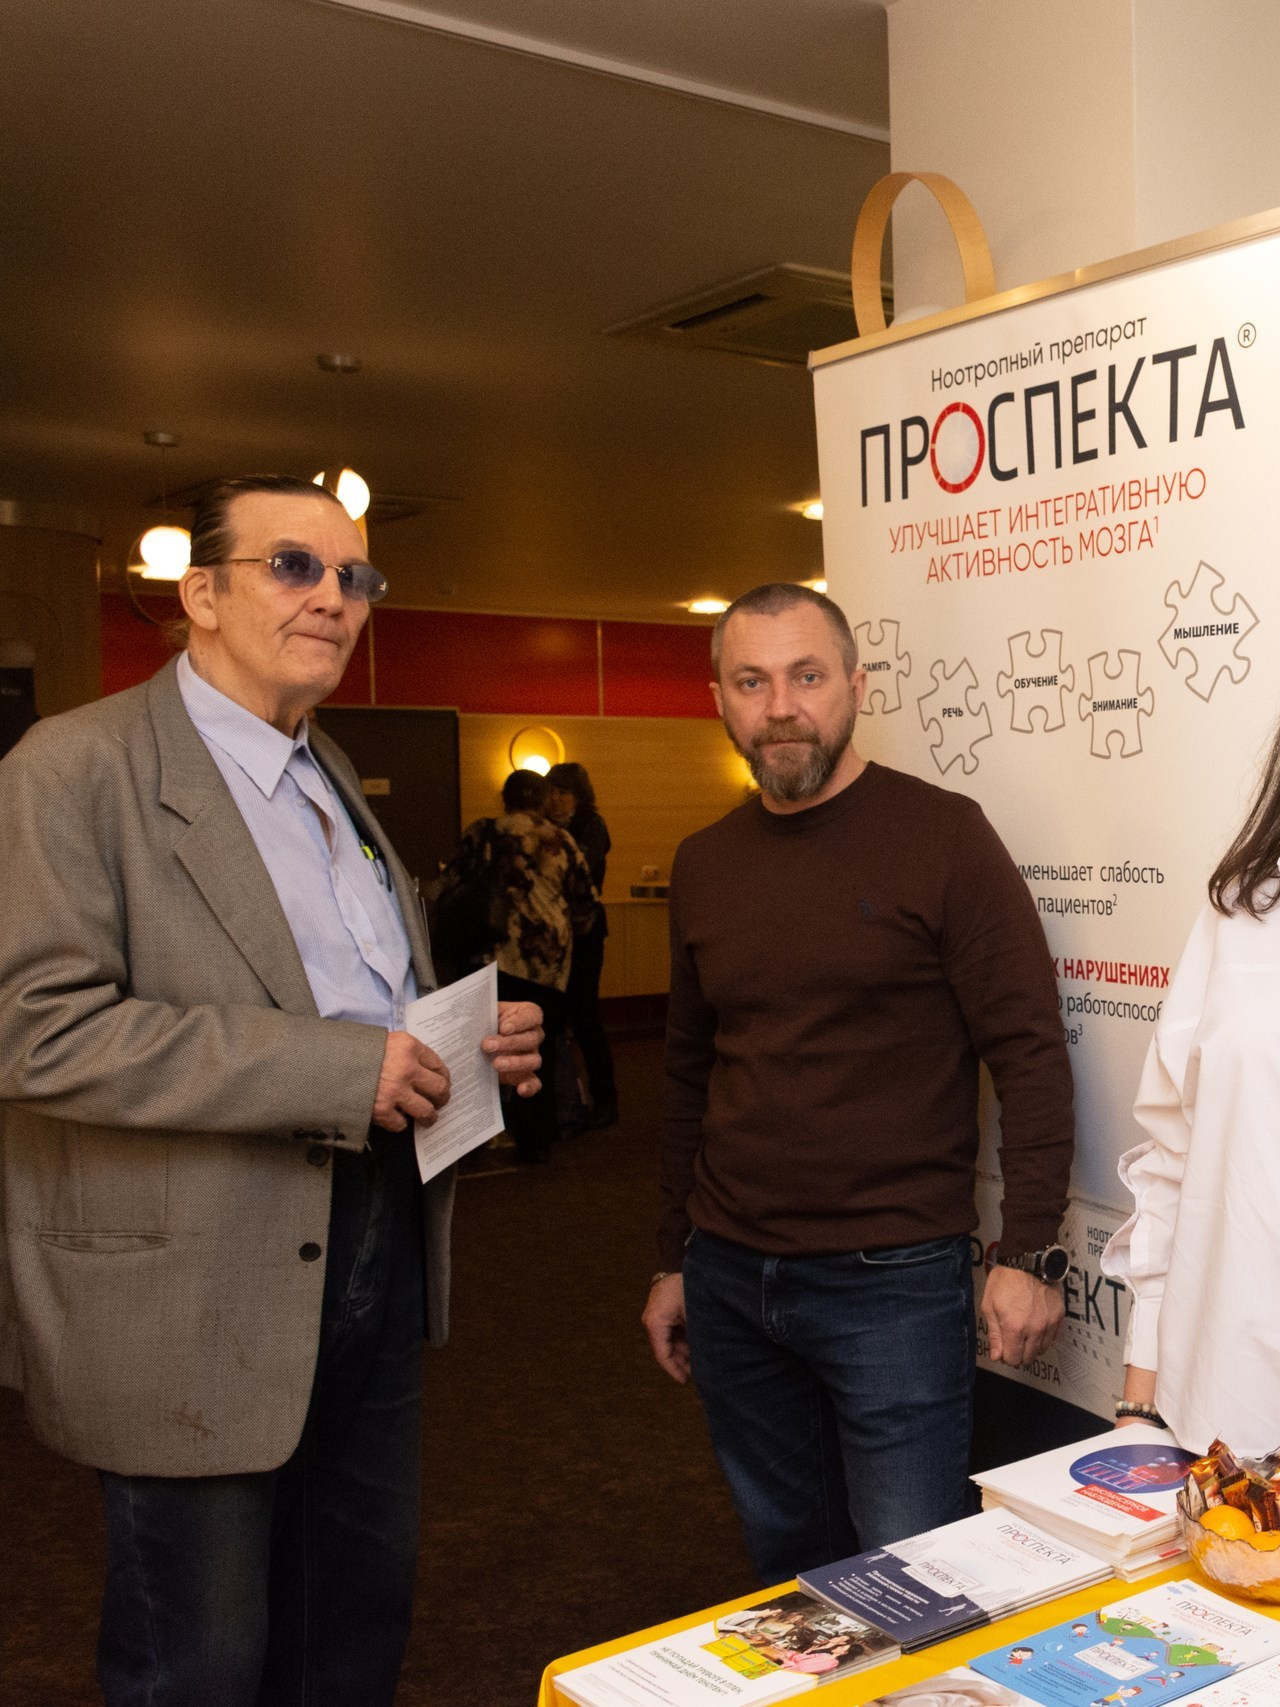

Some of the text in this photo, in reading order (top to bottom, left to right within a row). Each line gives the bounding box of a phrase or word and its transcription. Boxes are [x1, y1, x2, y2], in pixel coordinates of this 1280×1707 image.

[931, 316, 1147, 392] Ноотропный препарат
[890, 467, 1206, 554] УЛУЧШАЕТ ИНТЕГРАТИВНУЮ
[926, 533, 1074, 585] АКТИВНОСТЬ
[1173, 622, 1240, 641] МЫШЛЕНИЕ
[1014, 675, 1058, 690] ОБУЧЕНИЕ
[942, 707, 964, 718] РЕЧЬ
[1092, 697, 1138, 713] ВНИМАНИЕ
[1100, 860, 1165, 884] слабость
[1063, 957, 1170, 989] НАРУШЕНИЯХ
